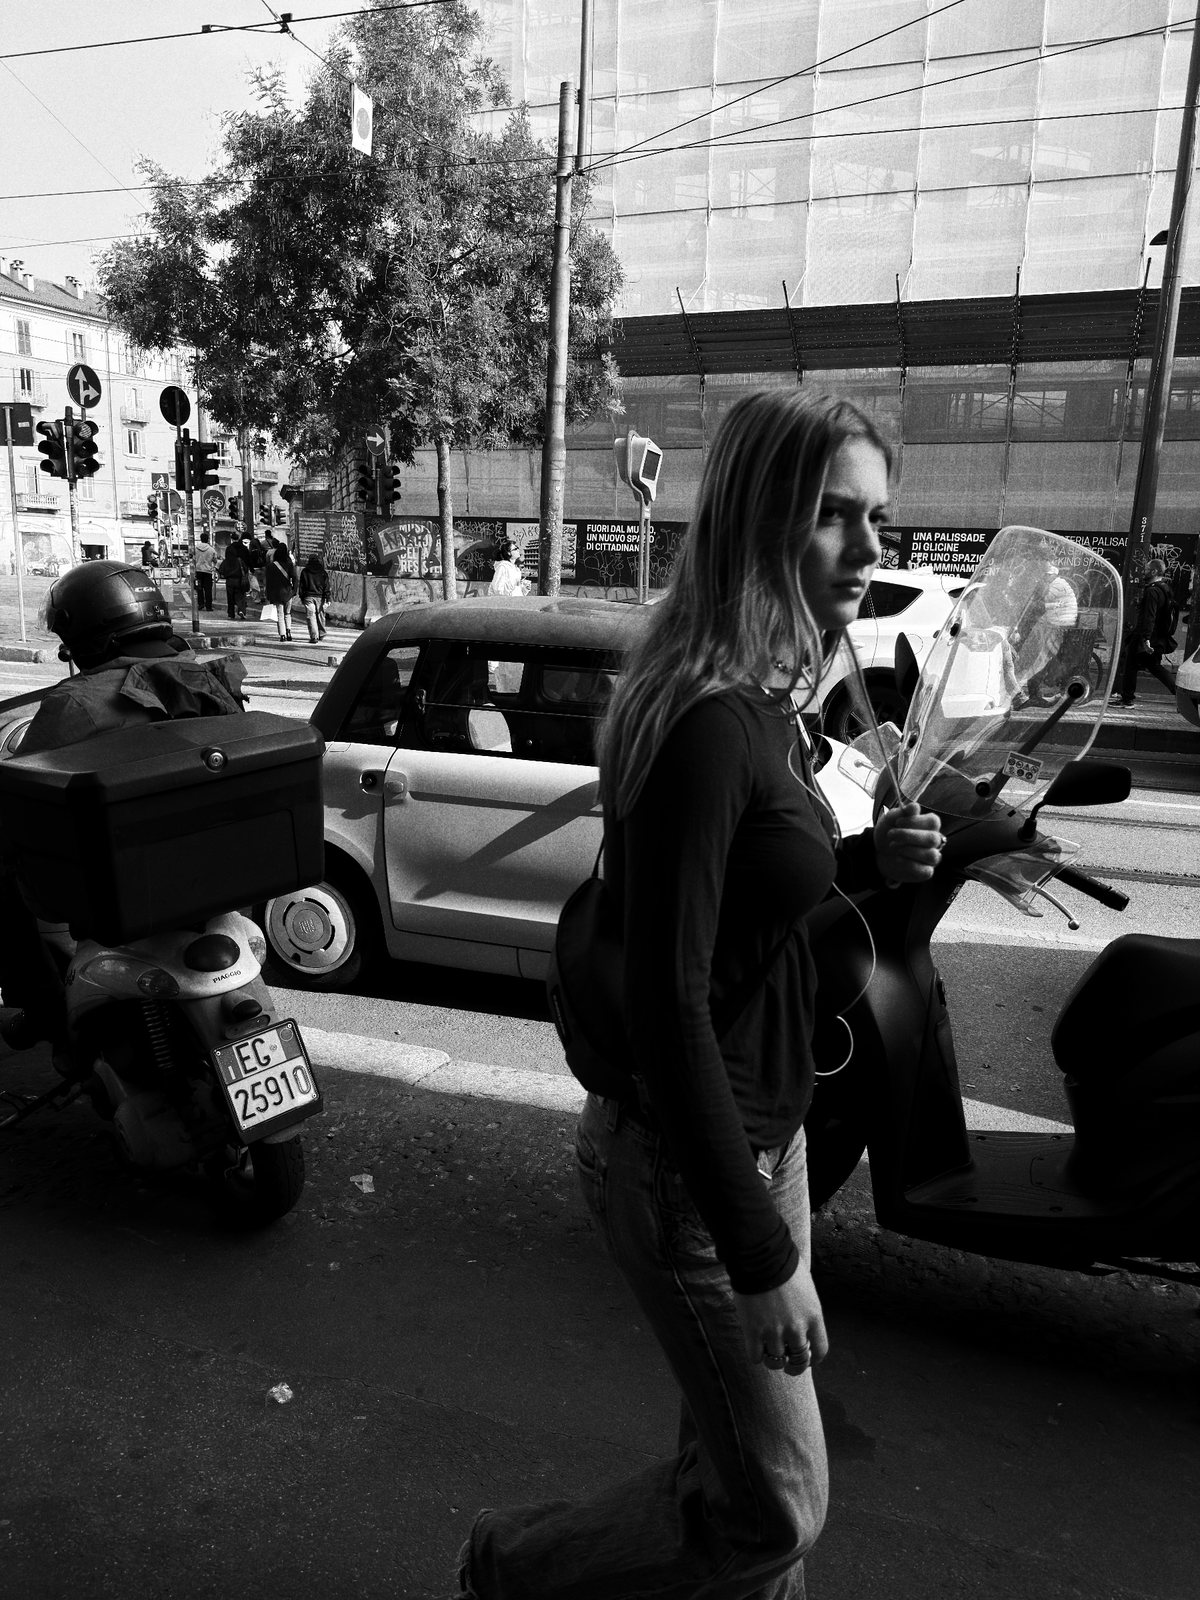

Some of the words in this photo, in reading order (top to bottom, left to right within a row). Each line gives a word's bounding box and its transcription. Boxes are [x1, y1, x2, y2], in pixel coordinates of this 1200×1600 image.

[586, 524, 609, 533] FUORI
[610, 525, 625, 533] DAL
[626, 525, 656, 535] MUO,
[586, 533, 598, 541] UN
[599, 534, 626, 543] NUOVO
[626, 535, 655, 544] SPAO
[913, 532, 932, 541] UNA
[934, 533, 986, 542] PALISSADE
[1091, 537, 1129, 547] PALISA
[586, 542, 594, 551] DI
[595, 543, 640, 552] CITTADINAN
[912, 542, 921, 551] DI
[923, 543, 959, 552] GLICINE
[911, 552, 929, 562] PER
[930, 553, 951, 562] UNO
[212, 970, 242, 983] PIAGGIO
[234, 1065, 311, 1121] 25910
